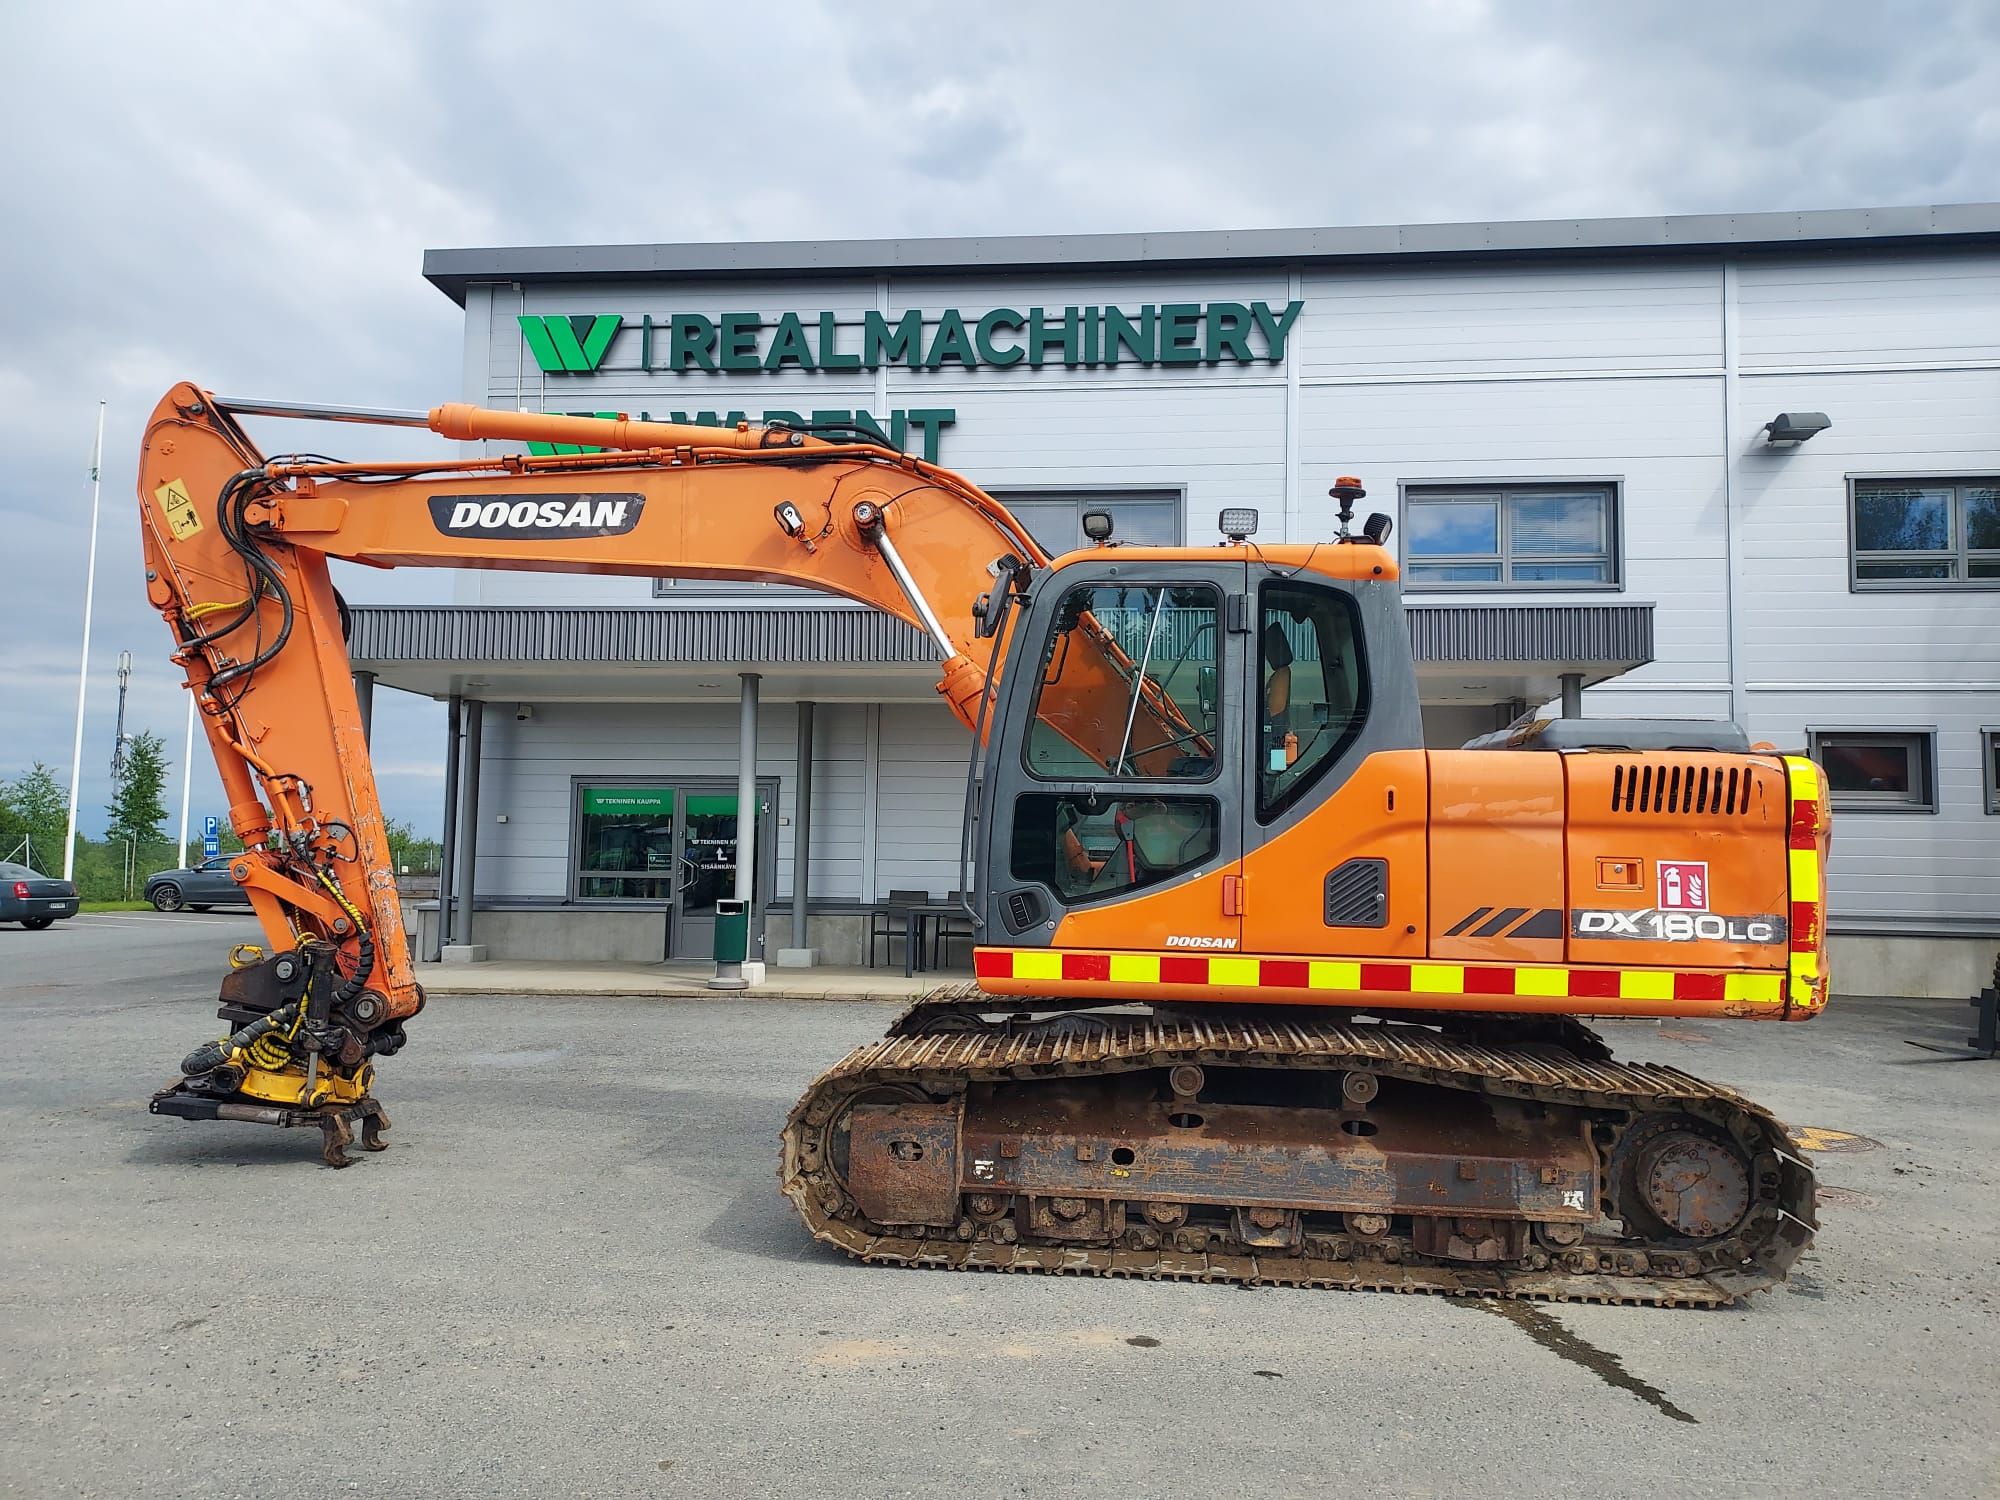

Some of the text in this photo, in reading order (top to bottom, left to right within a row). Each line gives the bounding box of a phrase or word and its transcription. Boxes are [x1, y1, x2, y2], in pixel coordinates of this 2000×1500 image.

[668, 300, 1306, 371] REALMACHINERY
[448, 500, 629, 529] DOOSAN
[207, 817, 216, 834] P
[1165, 935, 1238, 949] DOOSAN
